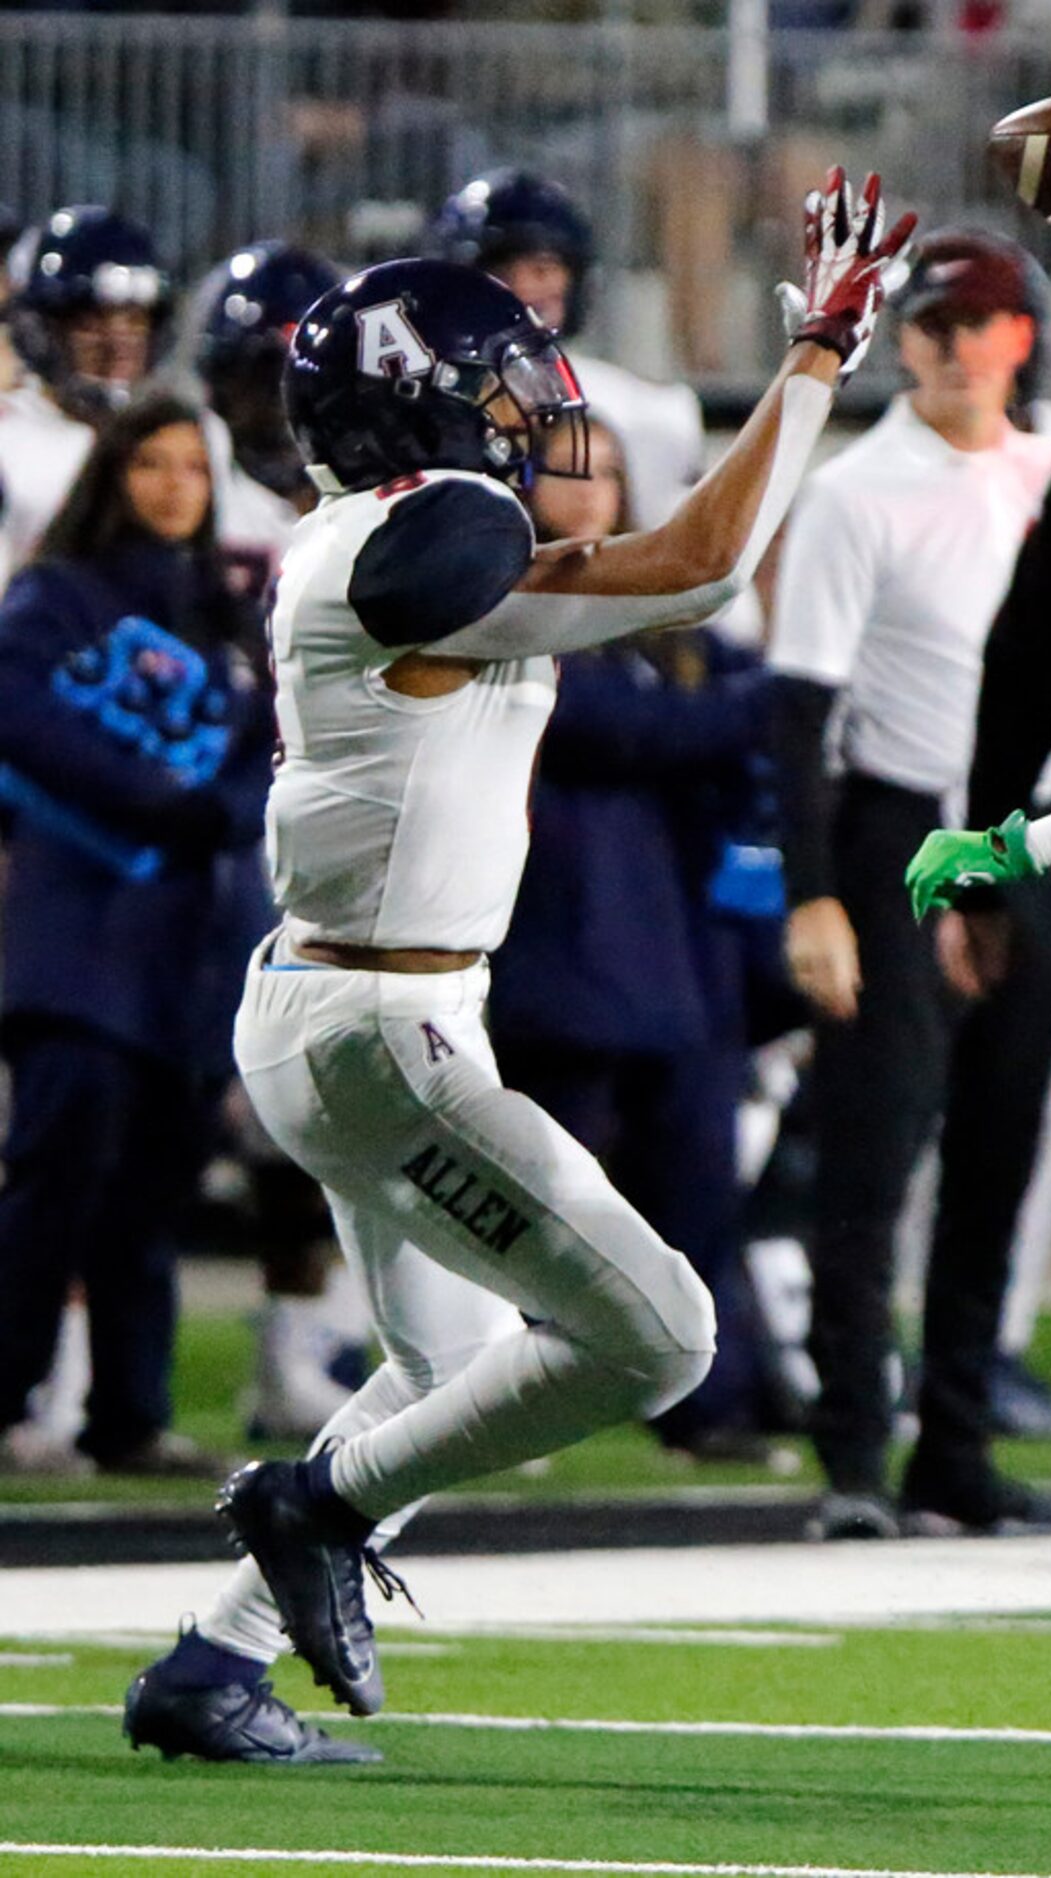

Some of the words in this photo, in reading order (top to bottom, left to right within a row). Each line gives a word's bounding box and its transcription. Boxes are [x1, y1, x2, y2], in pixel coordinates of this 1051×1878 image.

[355, 298, 436, 378] A
[420, 1020, 455, 1064] A
[402, 1144, 531, 1254] ALLEN
